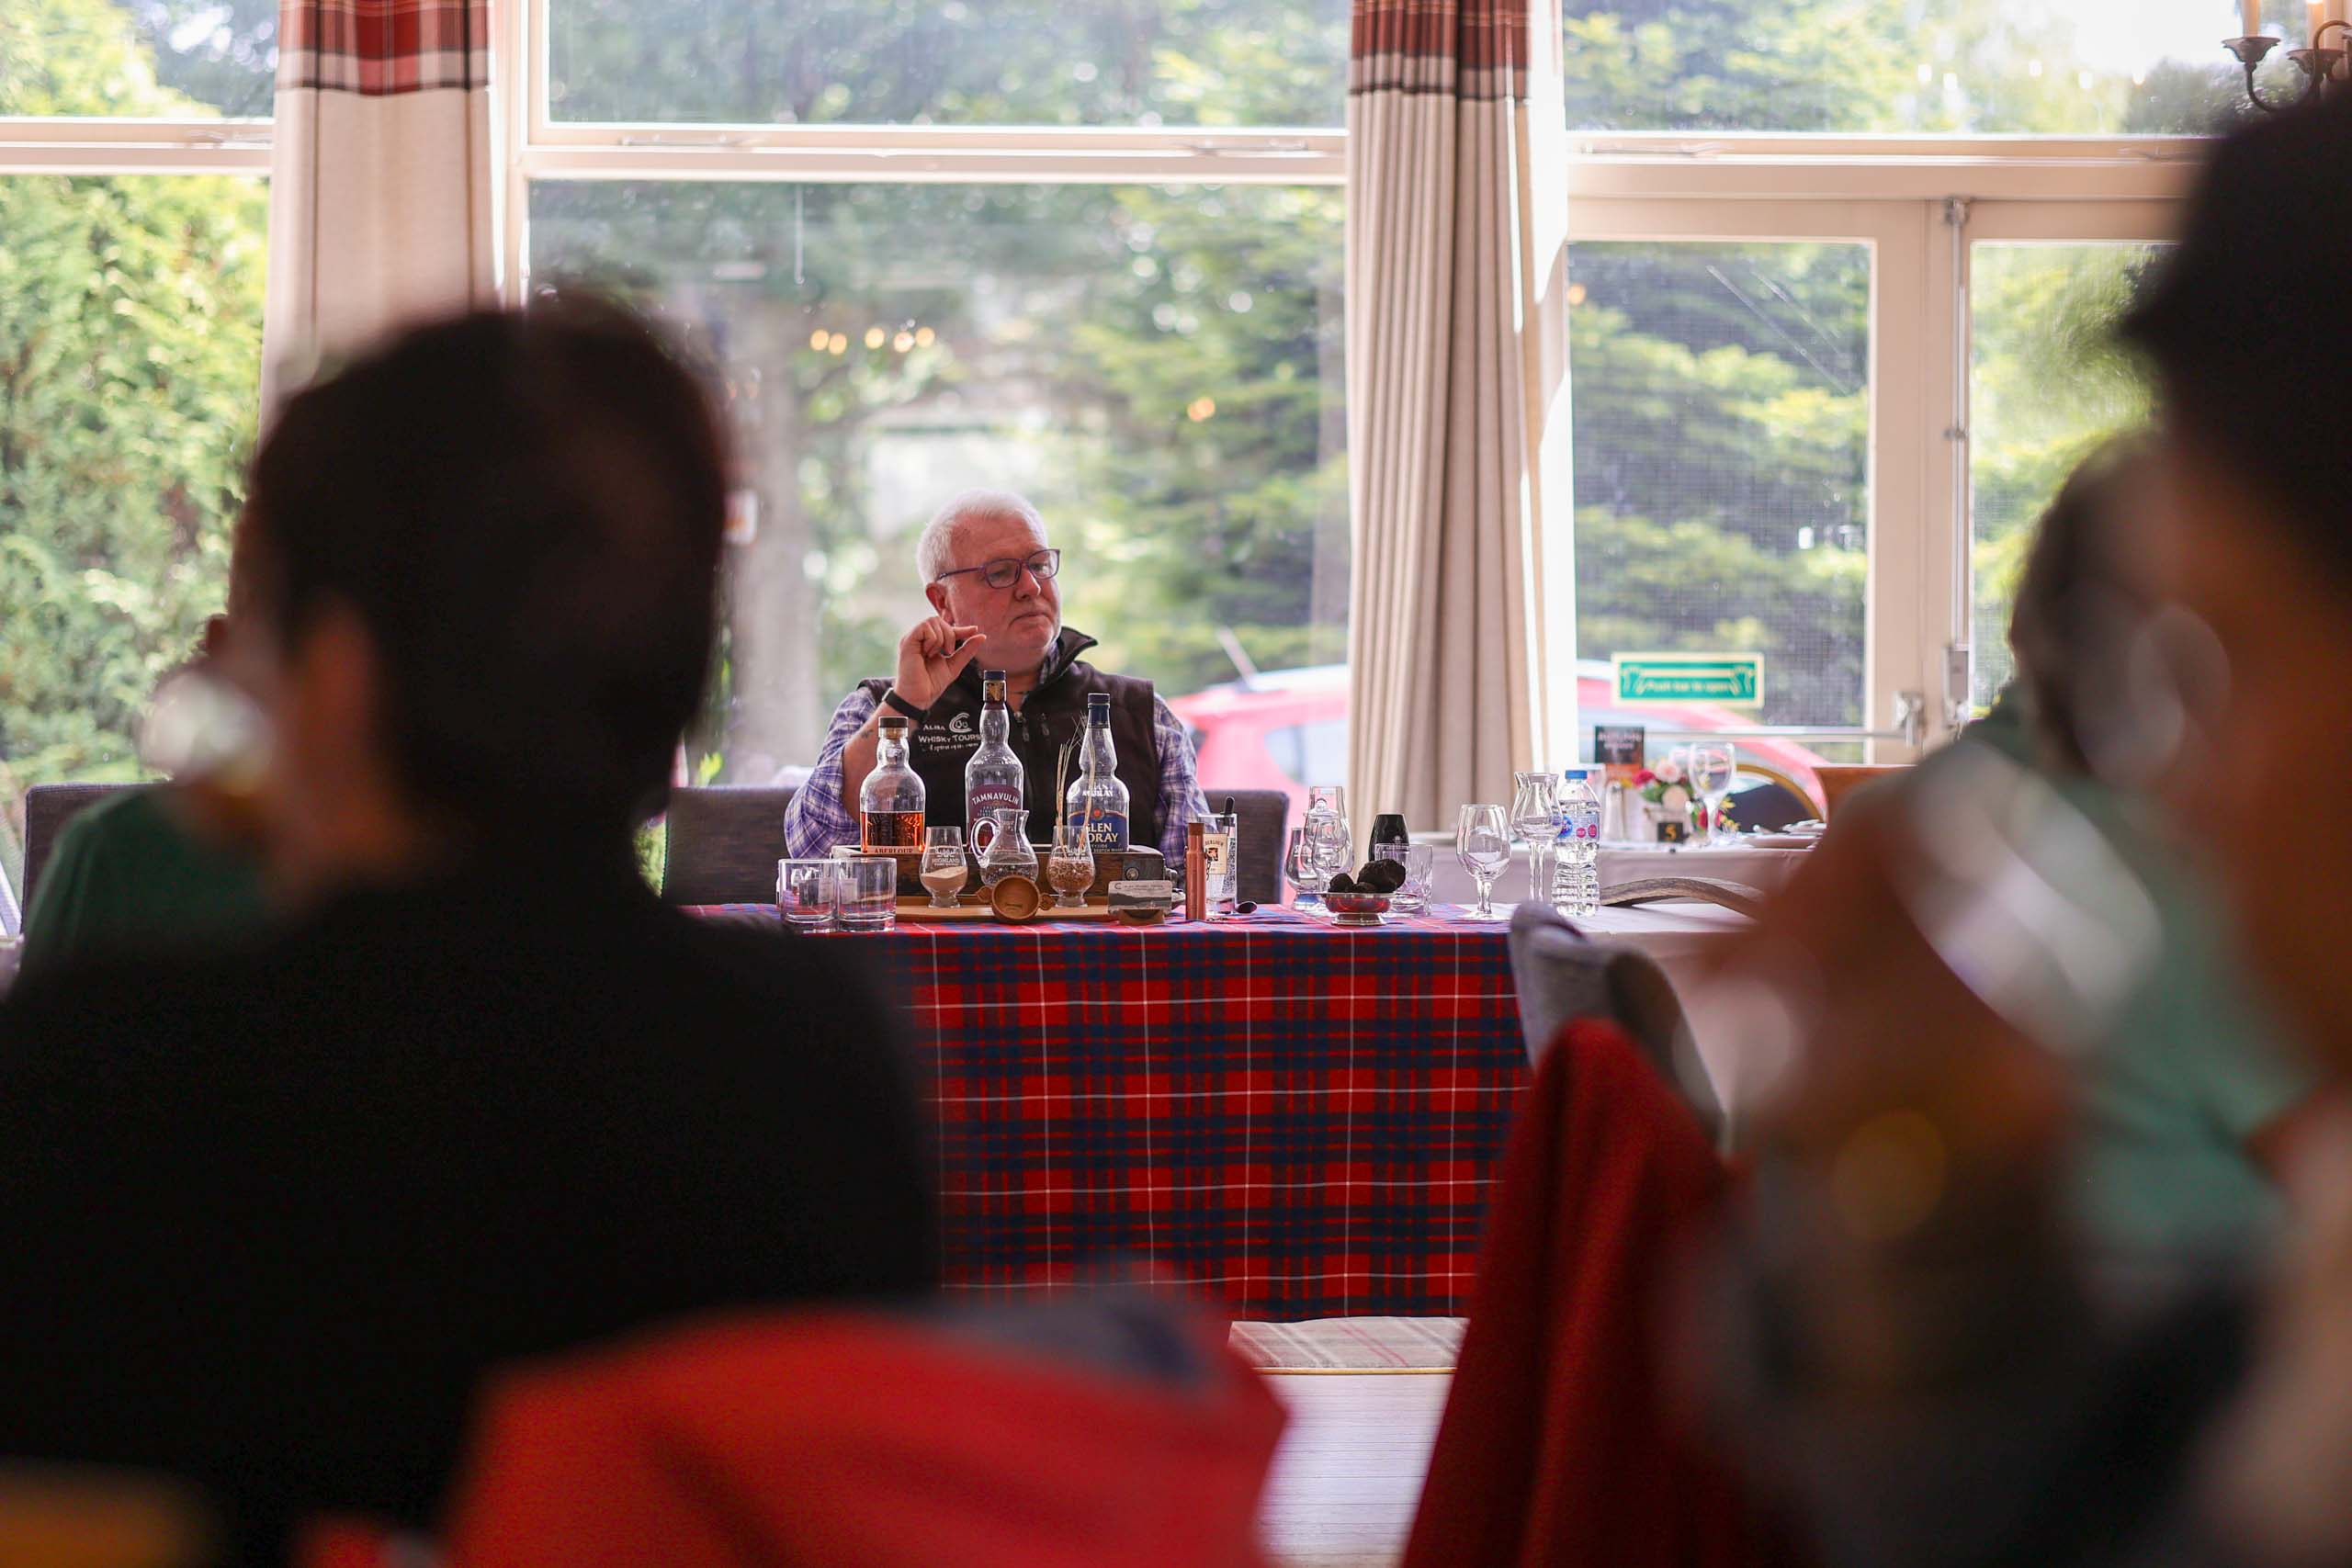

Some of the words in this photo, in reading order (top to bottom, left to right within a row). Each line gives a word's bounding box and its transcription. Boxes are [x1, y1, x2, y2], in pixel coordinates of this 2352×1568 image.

[918, 735, 951, 743] WHISKY
[971, 792, 1020, 806] TAMNAVULIN
[1087, 822, 1112, 832] GLEN
[1077, 832, 1118, 843] MORAY
